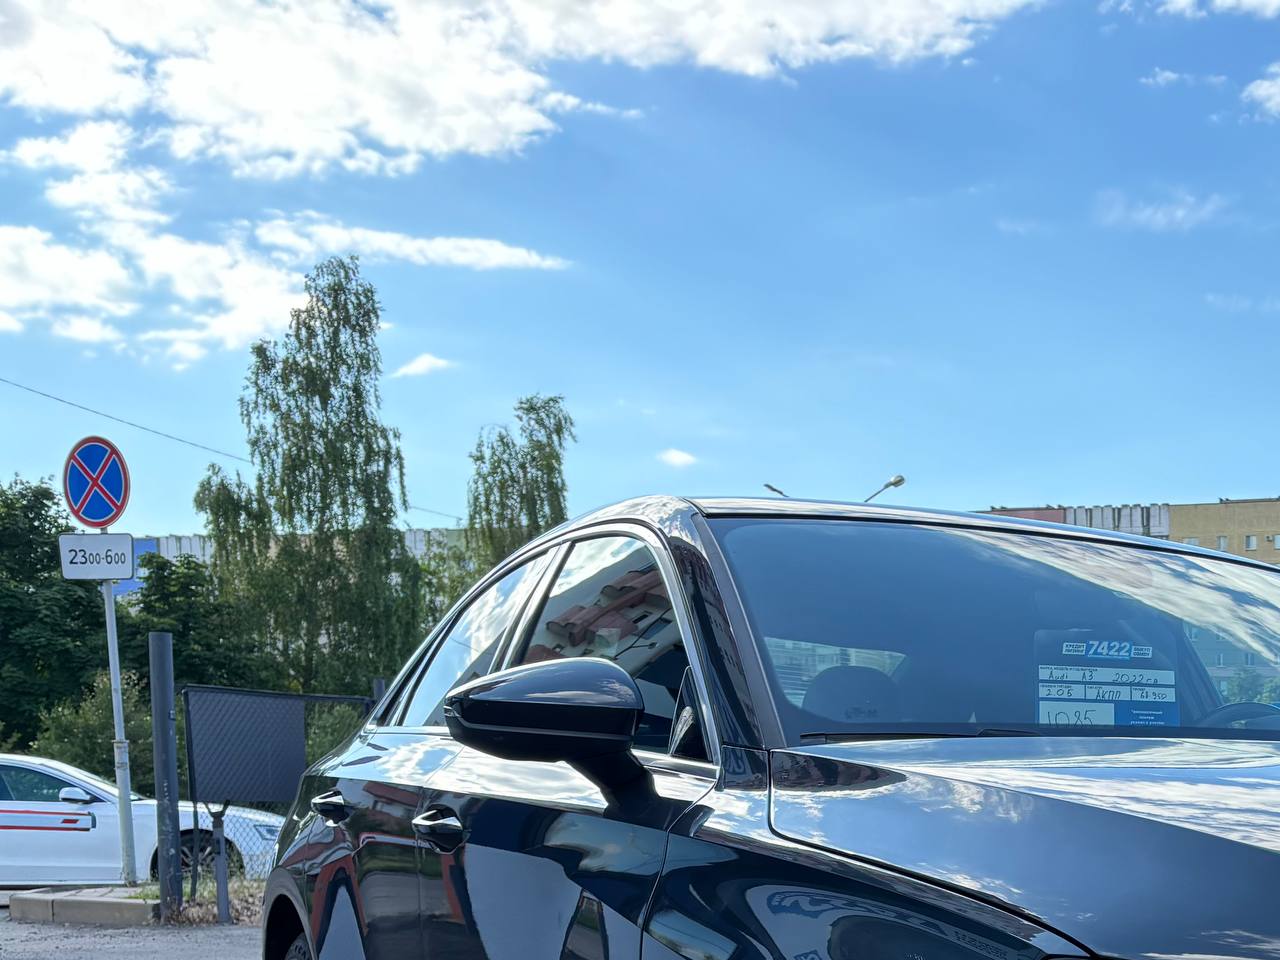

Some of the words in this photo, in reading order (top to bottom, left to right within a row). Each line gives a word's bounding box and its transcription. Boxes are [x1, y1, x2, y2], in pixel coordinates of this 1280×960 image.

[1088, 640, 1130, 656] 7422
[1048, 670, 1068, 680] Audi
[1081, 670, 1094, 681] A3
